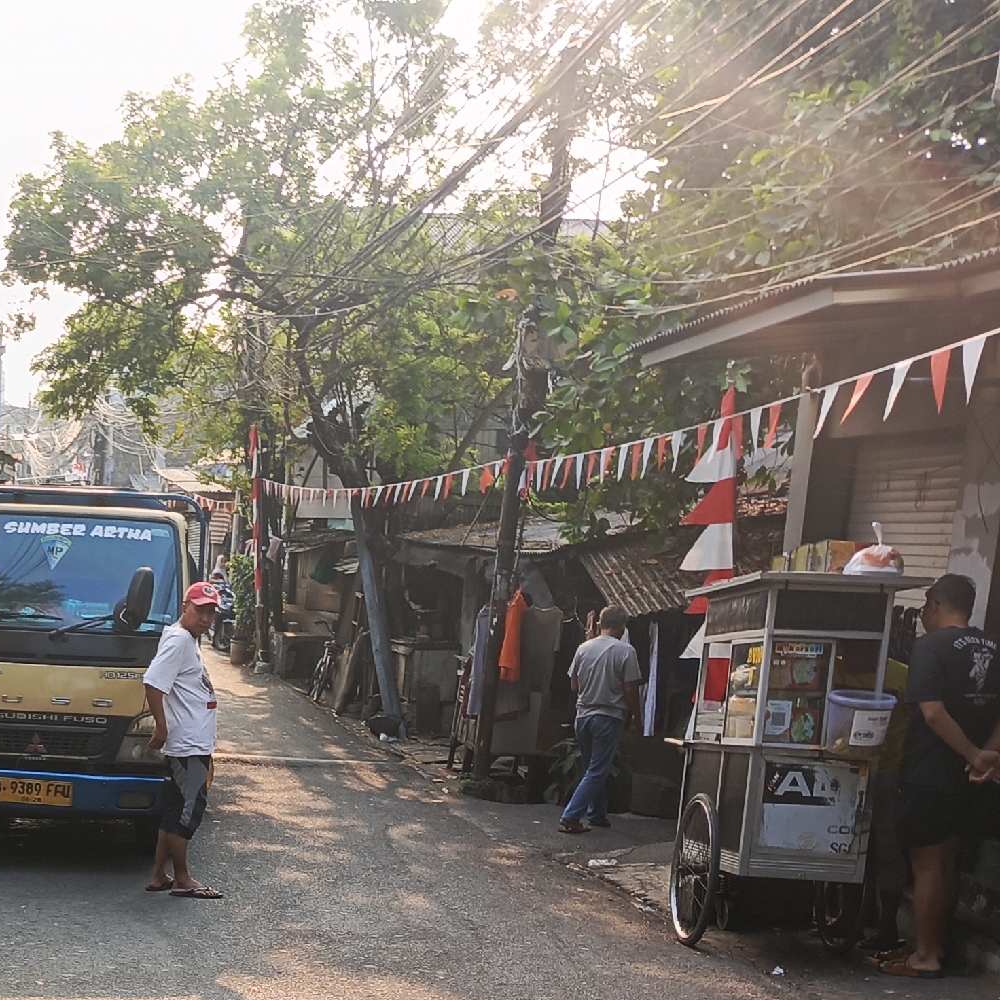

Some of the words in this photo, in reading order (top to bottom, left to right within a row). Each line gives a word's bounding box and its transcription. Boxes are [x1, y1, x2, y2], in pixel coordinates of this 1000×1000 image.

[3, 521, 87, 536] SUMBER
[89, 525, 152, 541] ARTHA
[63, 715, 108, 724] FUSO
[10, 781, 42, 796] 9389
